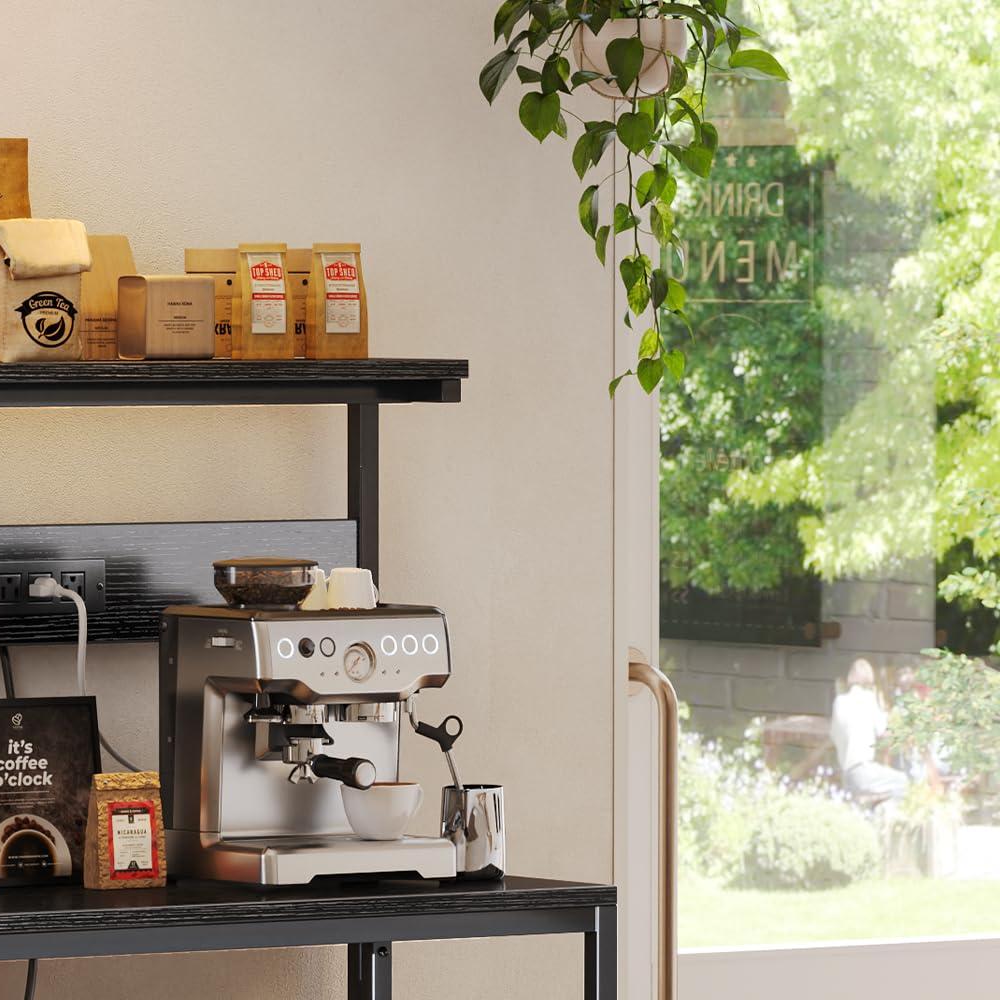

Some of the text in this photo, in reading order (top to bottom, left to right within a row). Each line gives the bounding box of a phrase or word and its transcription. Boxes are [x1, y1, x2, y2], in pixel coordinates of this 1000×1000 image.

[252, 267, 282, 278] TOP SHED
[326, 267, 355, 278] TOP SHED
[29, 298, 70, 311] Green Tea
[8, 739, 33, 755] it's
